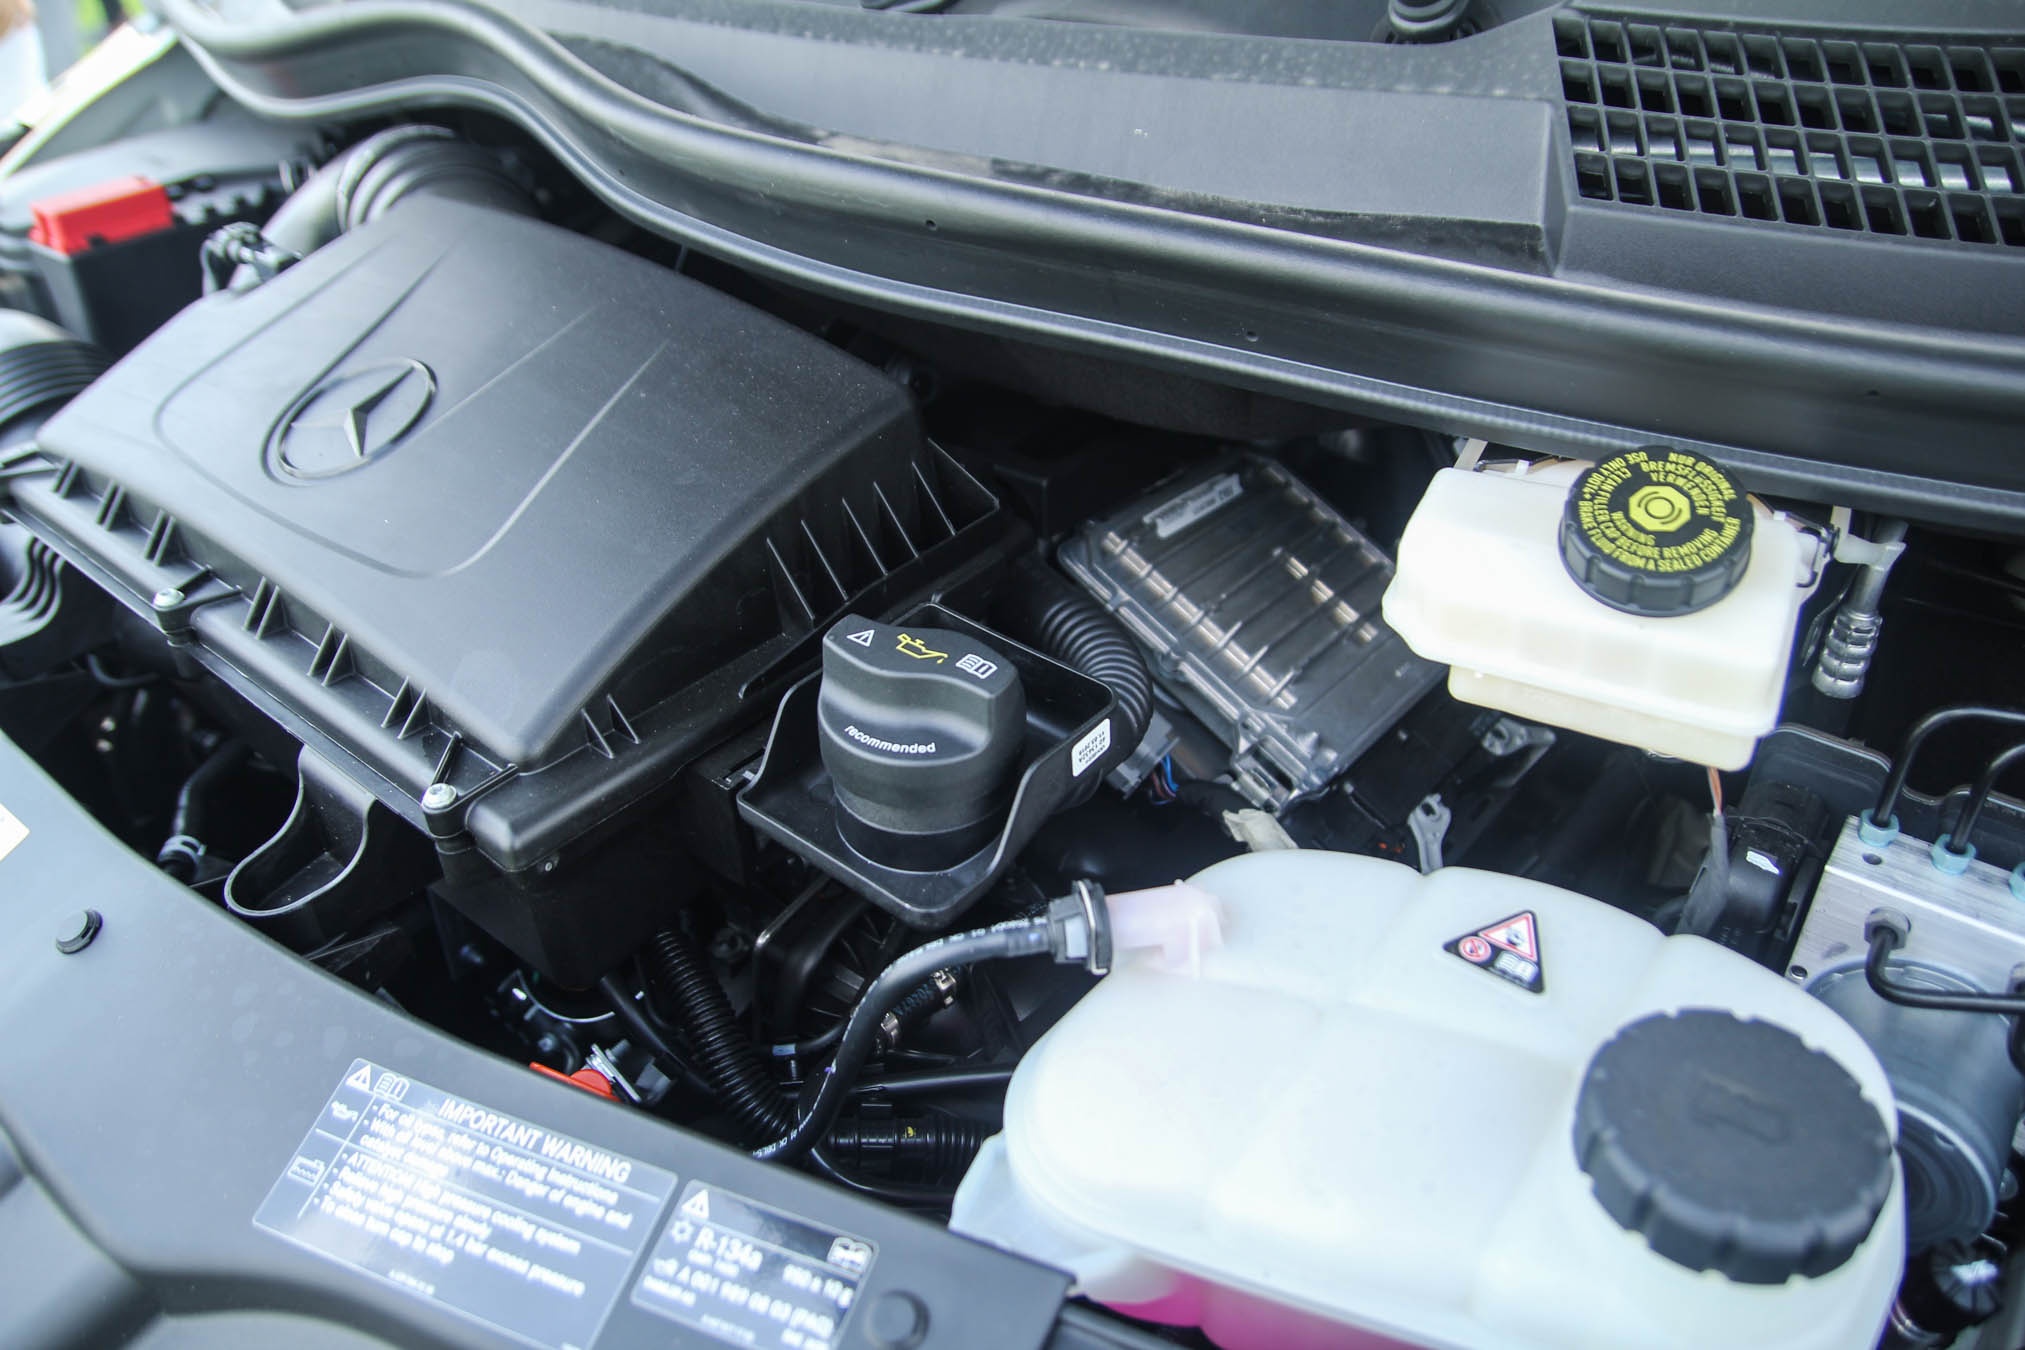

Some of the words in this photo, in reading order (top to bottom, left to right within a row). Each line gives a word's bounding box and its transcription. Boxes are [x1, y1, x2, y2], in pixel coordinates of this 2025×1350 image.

[1599, 457, 1627, 477] ONLY
[1624, 451, 1648, 464] USE
[1600, 468, 1632, 492] CLEAN
[1668, 452, 1696, 467] NUR
[1694, 461, 1737, 501] ORIGINAL
[1578, 501, 1598, 530] BRAKE
[1593, 490, 1611, 523] FILLER
[1587, 528, 1617, 555] FLUID
[1599, 522, 1621, 539] CAP
[1662, 528, 1719, 559] REMOVING
[1699, 516, 1741, 562] CONTAINER
[1646, 558, 1656, 571] A
[1657, 554, 1703, 572] SEALED
[845, 725, 936, 754] recommended
[379, 1104, 399, 1119] For
[488, 1146, 548, 1180] Operating
[547, 1167, 619, 1204] Instructions
[438, 1098, 541, 1148] IMPORTANT
[540, 1135, 632, 1181] WARNING
[503, 1171, 549, 1199] Danger
[561, 1192, 606, 1221] engine
[604, 1207, 632, 1228] and
[695, 1227, 762, 1272] R-134a
[527, 1263, 586, 1298] pressure
